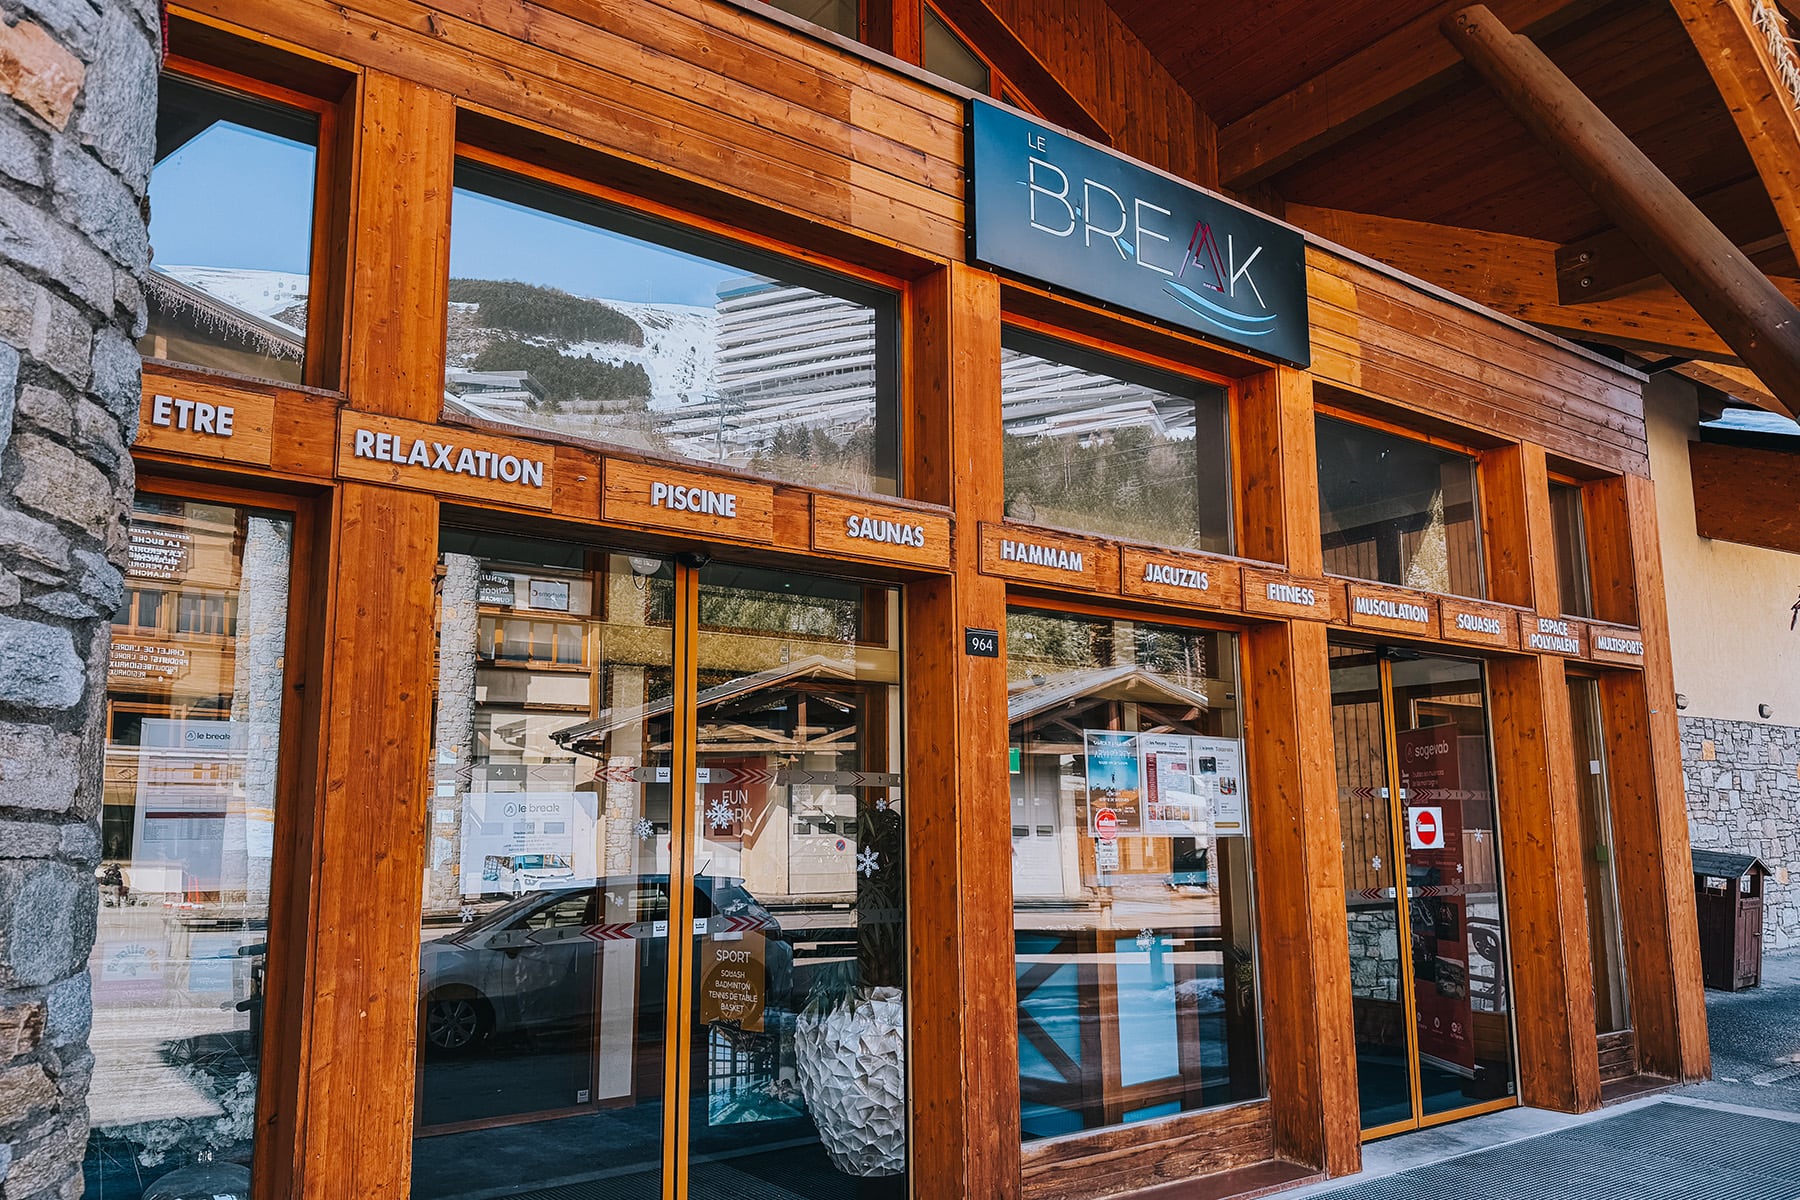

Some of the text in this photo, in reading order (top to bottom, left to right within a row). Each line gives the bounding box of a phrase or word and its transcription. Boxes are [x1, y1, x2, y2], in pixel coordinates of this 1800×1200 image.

[1028, 132, 1046, 153] LE
[1028, 156, 1266, 309] BREAK
[152, 395, 235, 437] ETRE
[354, 428, 544, 488] RELAXATION
[650, 481, 736, 518] PISCINE
[846, 514, 925, 548] SAUNAS
[1000, 539, 1083, 572] HAMMAM
[1143, 563, 1209, 591] JACUZZIS
[1266, 582, 1315, 606] FITNESS
[1353, 596, 1430, 624] MUSCULATION
[1455, 612, 1501, 635] SQUASHS
[1537, 618, 1568, 636] ESPACE
[972, 629, 993, 652] 964
[1529, 634, 1580, 654] POLYVALENT
[1596, 635, 1645, 657] MULTISPORTS
[196, 732, 231, 741] le break
[1415, 739, 1449, 761] sogevab
[518, 803, 560, 813] le break
[722, 789, 749, 805] FUN
[716, 949, 751, 964] SPORT
[715, 980, 751, 990] BADMINTON
[720, 969, 746, 979] SQUASH
[708, 990, 729, 1000] TENNIS
[738, 994, 758, 1003] TABLE
[720, 1002, 745, 1012] BASKET
